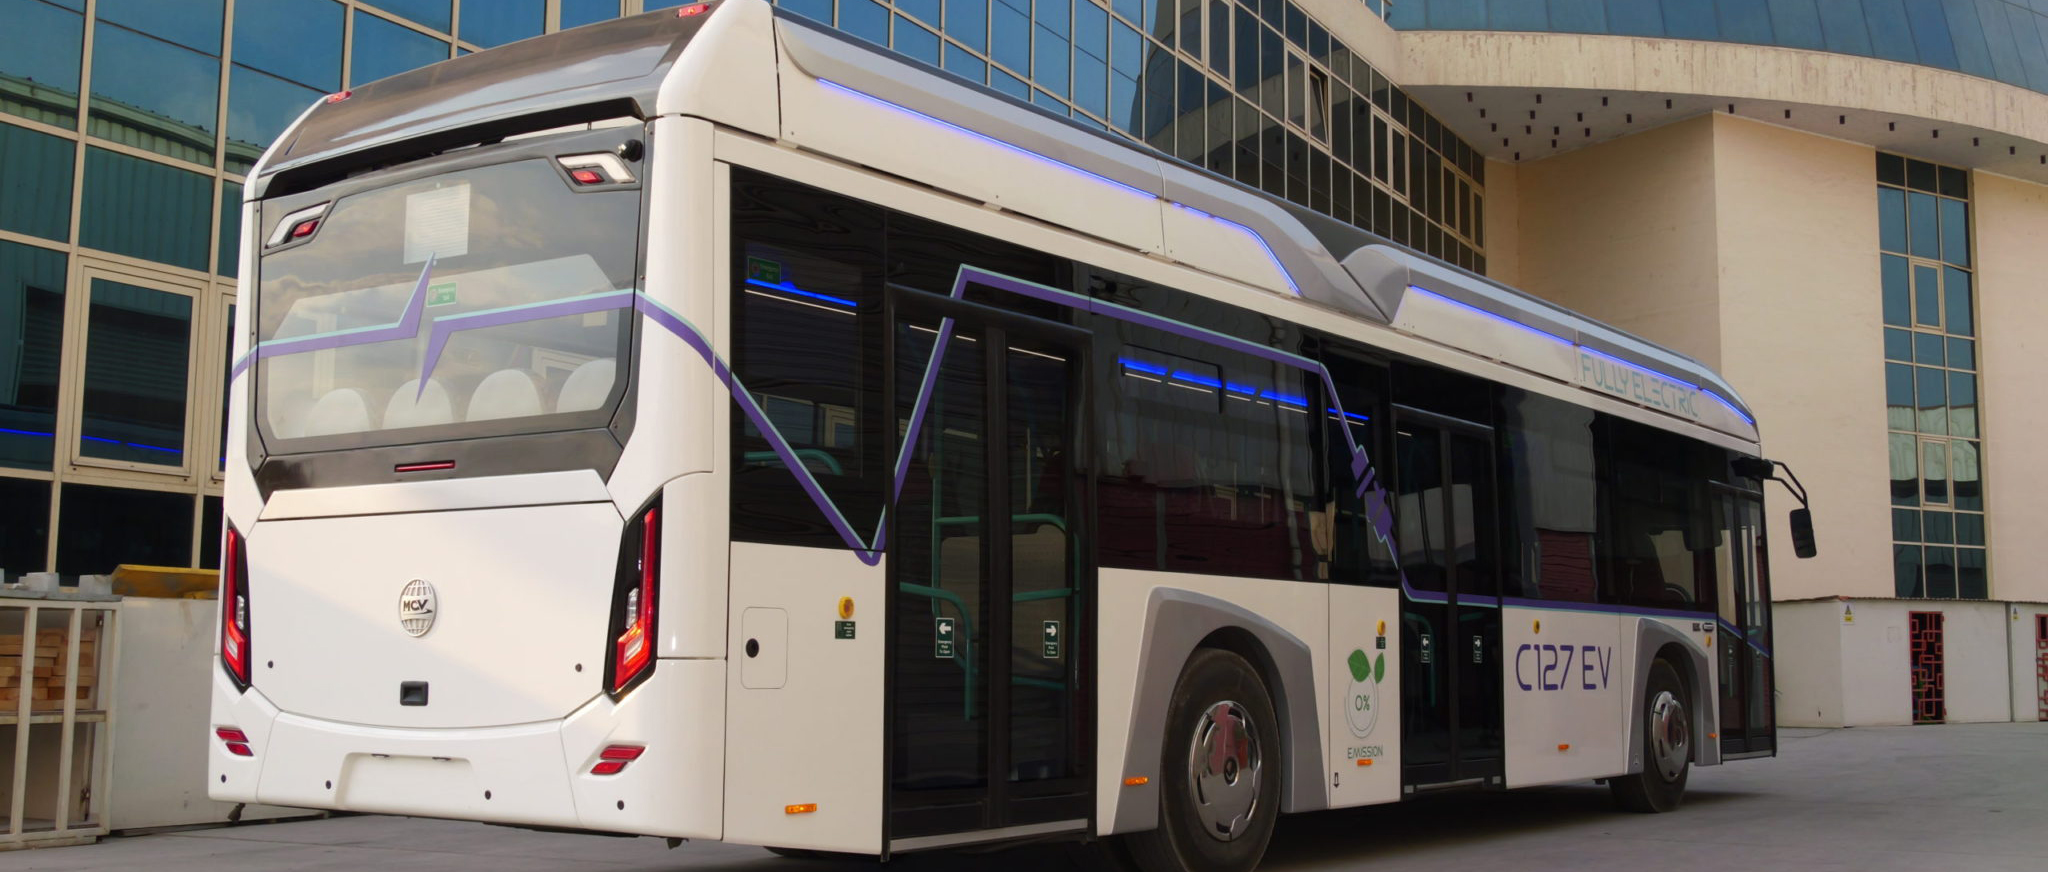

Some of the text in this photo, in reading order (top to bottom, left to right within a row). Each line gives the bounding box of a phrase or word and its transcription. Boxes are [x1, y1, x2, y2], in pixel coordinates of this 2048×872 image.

[1581, 354, 1698, 418] FULLY ELECTRIC
[403, 599, 428, 612] MCV
[1516, 644, 1611, 691] C127 EV
[1355, 694, 1370, 711] 0%
[1347, 745, 1384, 759] EMISSION
